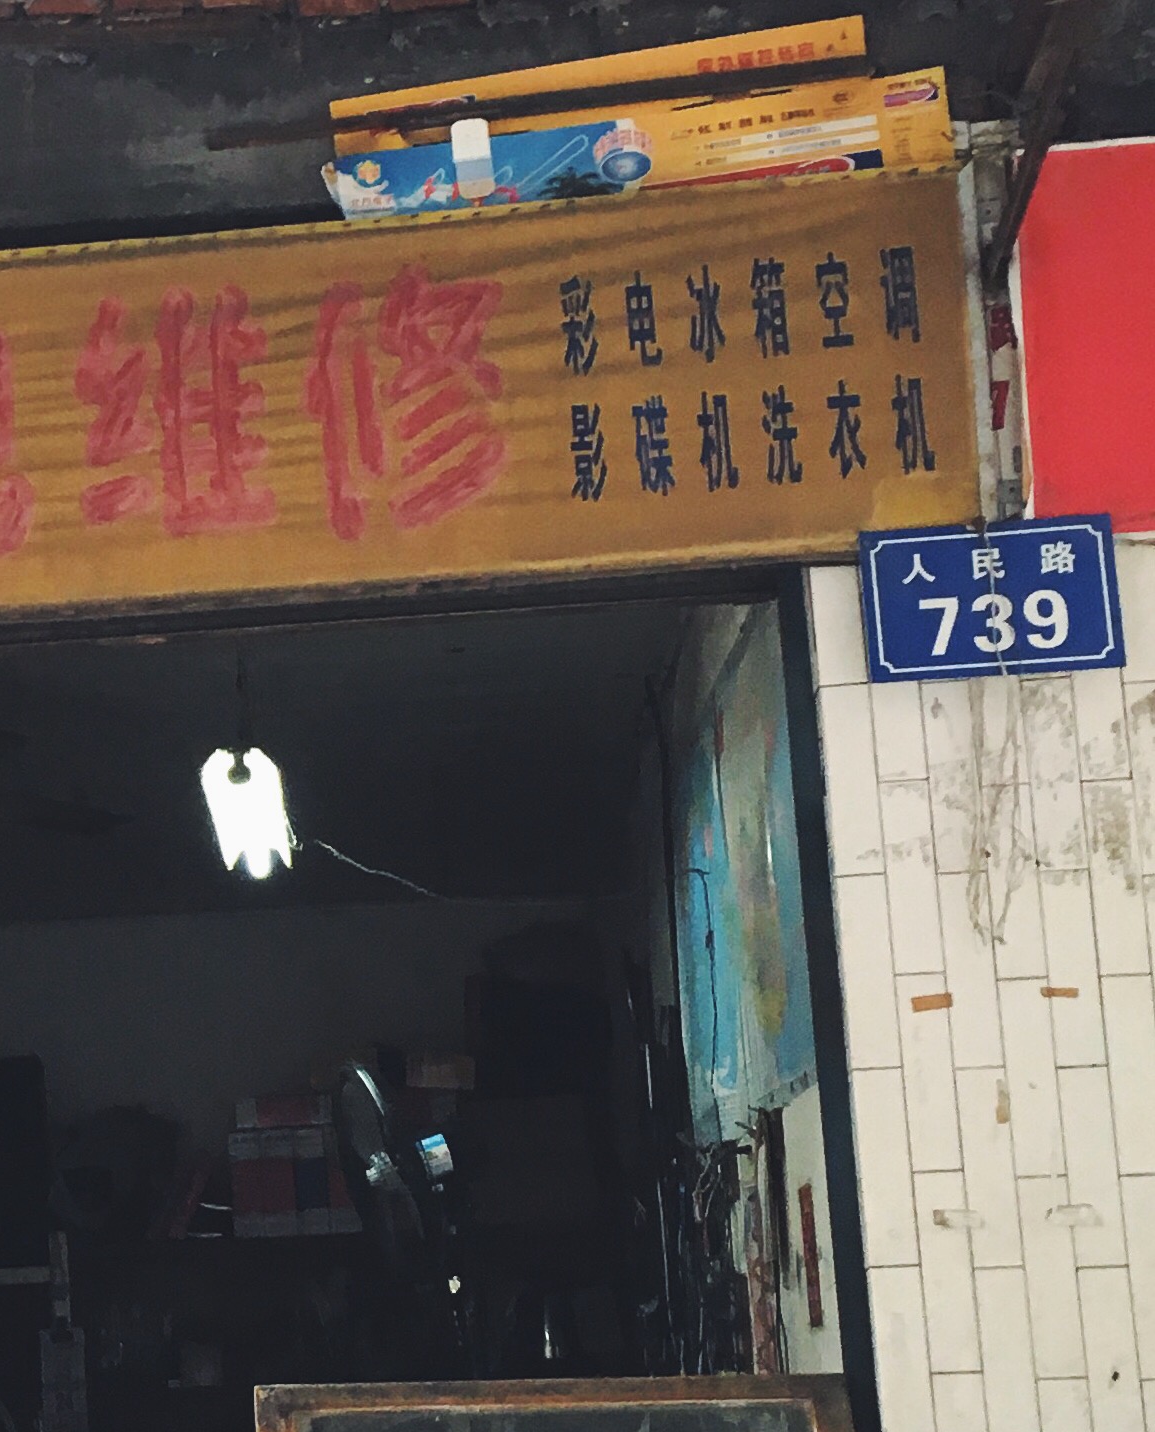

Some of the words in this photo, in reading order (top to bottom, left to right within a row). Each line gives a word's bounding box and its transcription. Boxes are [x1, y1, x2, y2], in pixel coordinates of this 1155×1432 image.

[558, 245, 921, 376] 彩电冰箱空调
[569, 374, 936, 502] 影碟机洗衣机
[901, 541, 1076, 585] 人民路
[918, 589, 1070, 656] 739
